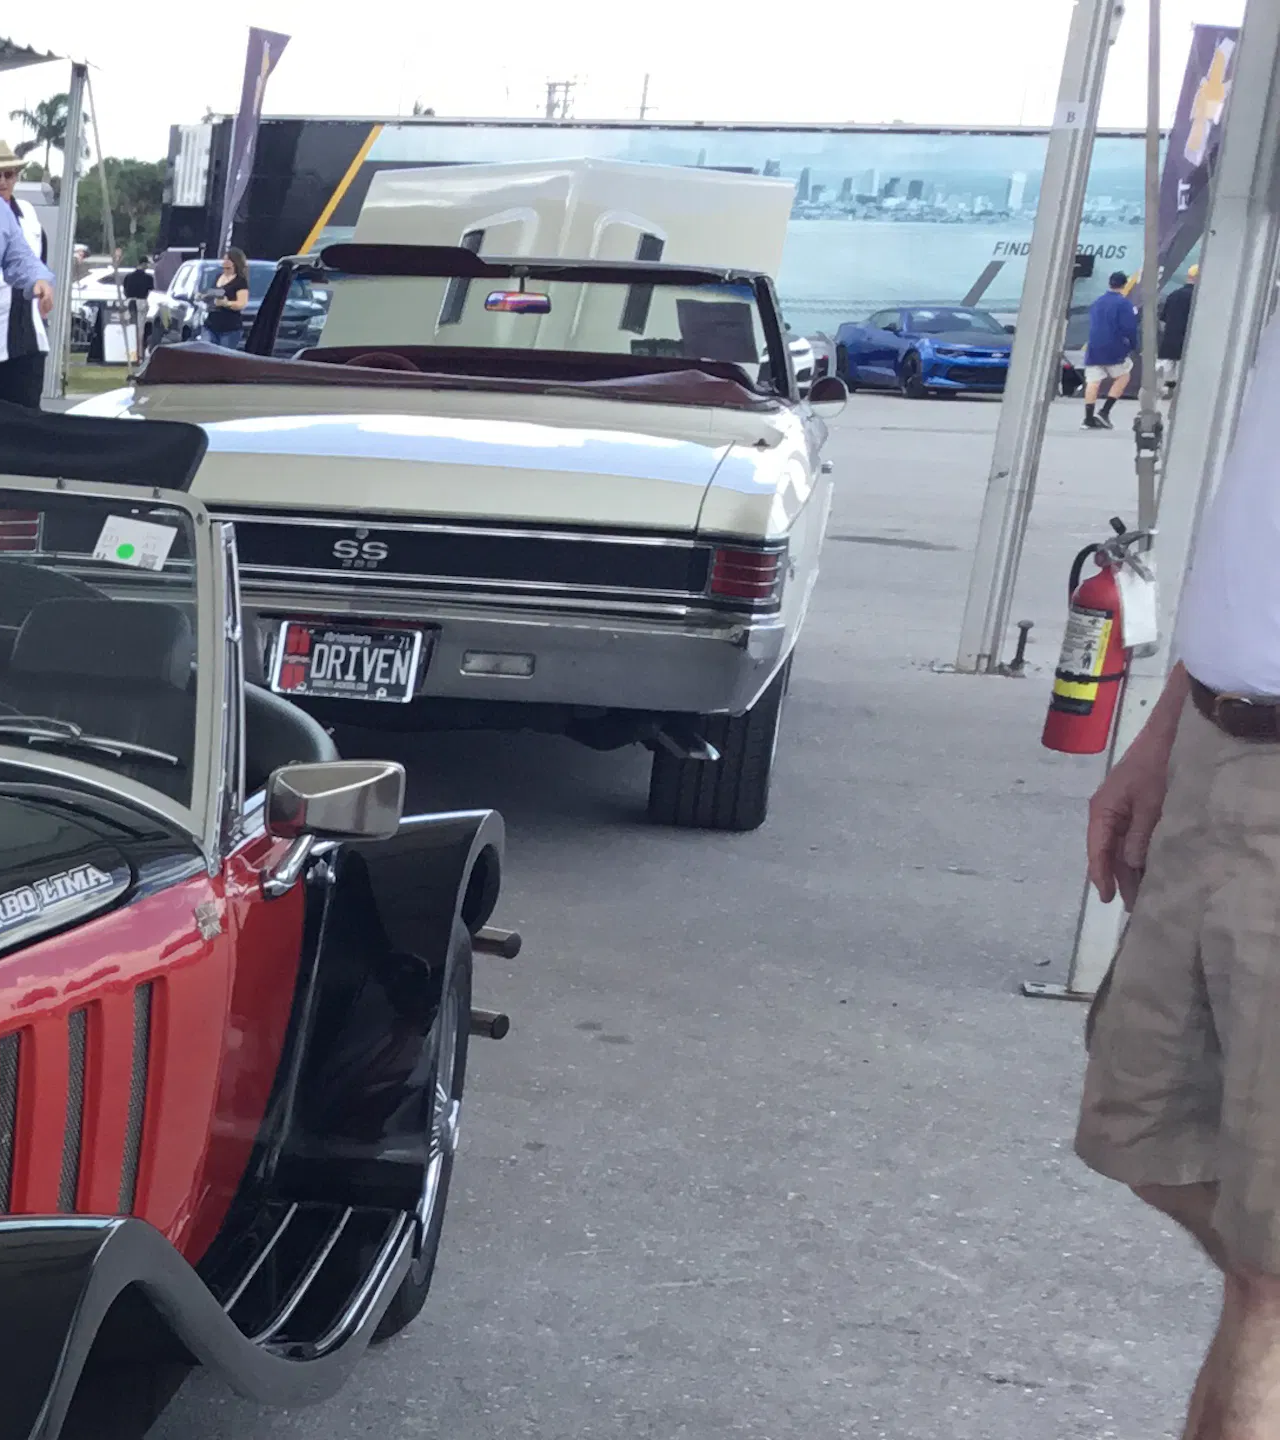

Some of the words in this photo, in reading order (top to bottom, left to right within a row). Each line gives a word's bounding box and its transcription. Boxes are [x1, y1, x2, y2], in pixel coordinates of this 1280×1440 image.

[1066, 111, 1076, 123] B
[993, 241, 1031, 256] FIND
[332, 539, 389, 560] SS
[310, 643, 411, 685] DRIVEN
[36, 864, 113, 906] LIMA
